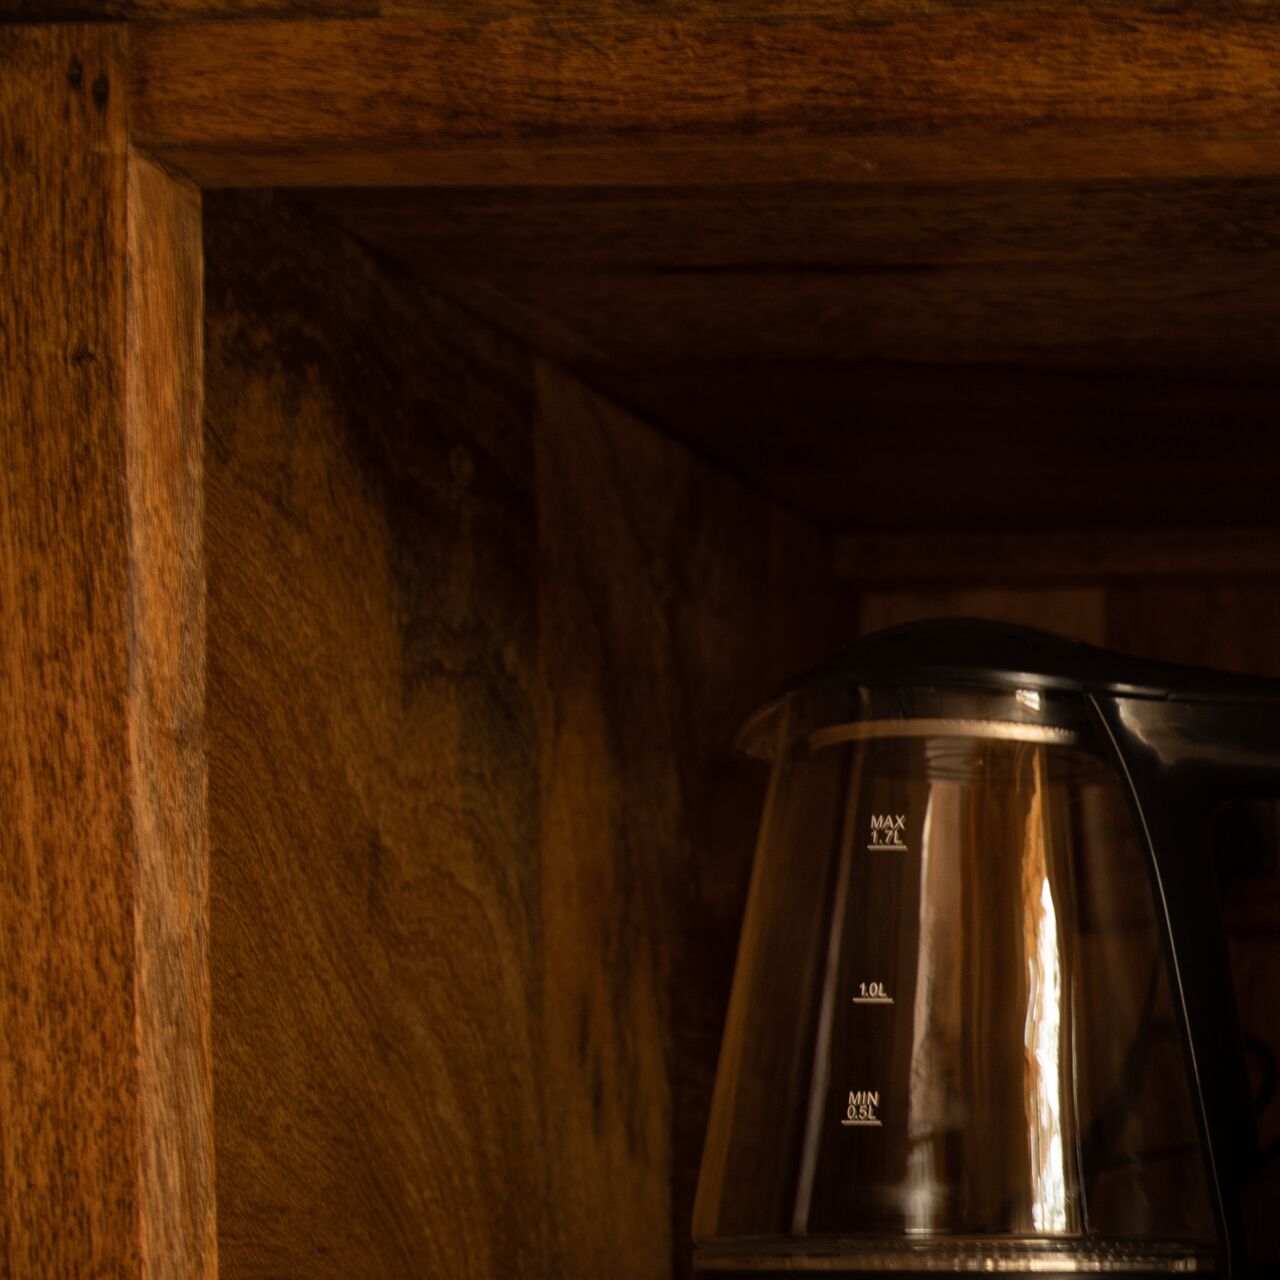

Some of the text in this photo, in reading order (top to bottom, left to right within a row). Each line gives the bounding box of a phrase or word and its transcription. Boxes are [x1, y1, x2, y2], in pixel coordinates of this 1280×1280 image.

[870, 814, 906, 830] MAX
[870, 830, 903, 844] 1.7L
[859, 982, 888, 997] 1.0L
[848, 1091, 880, 1105] MIN
[847, 1105, 876, 1120] 0.5L
